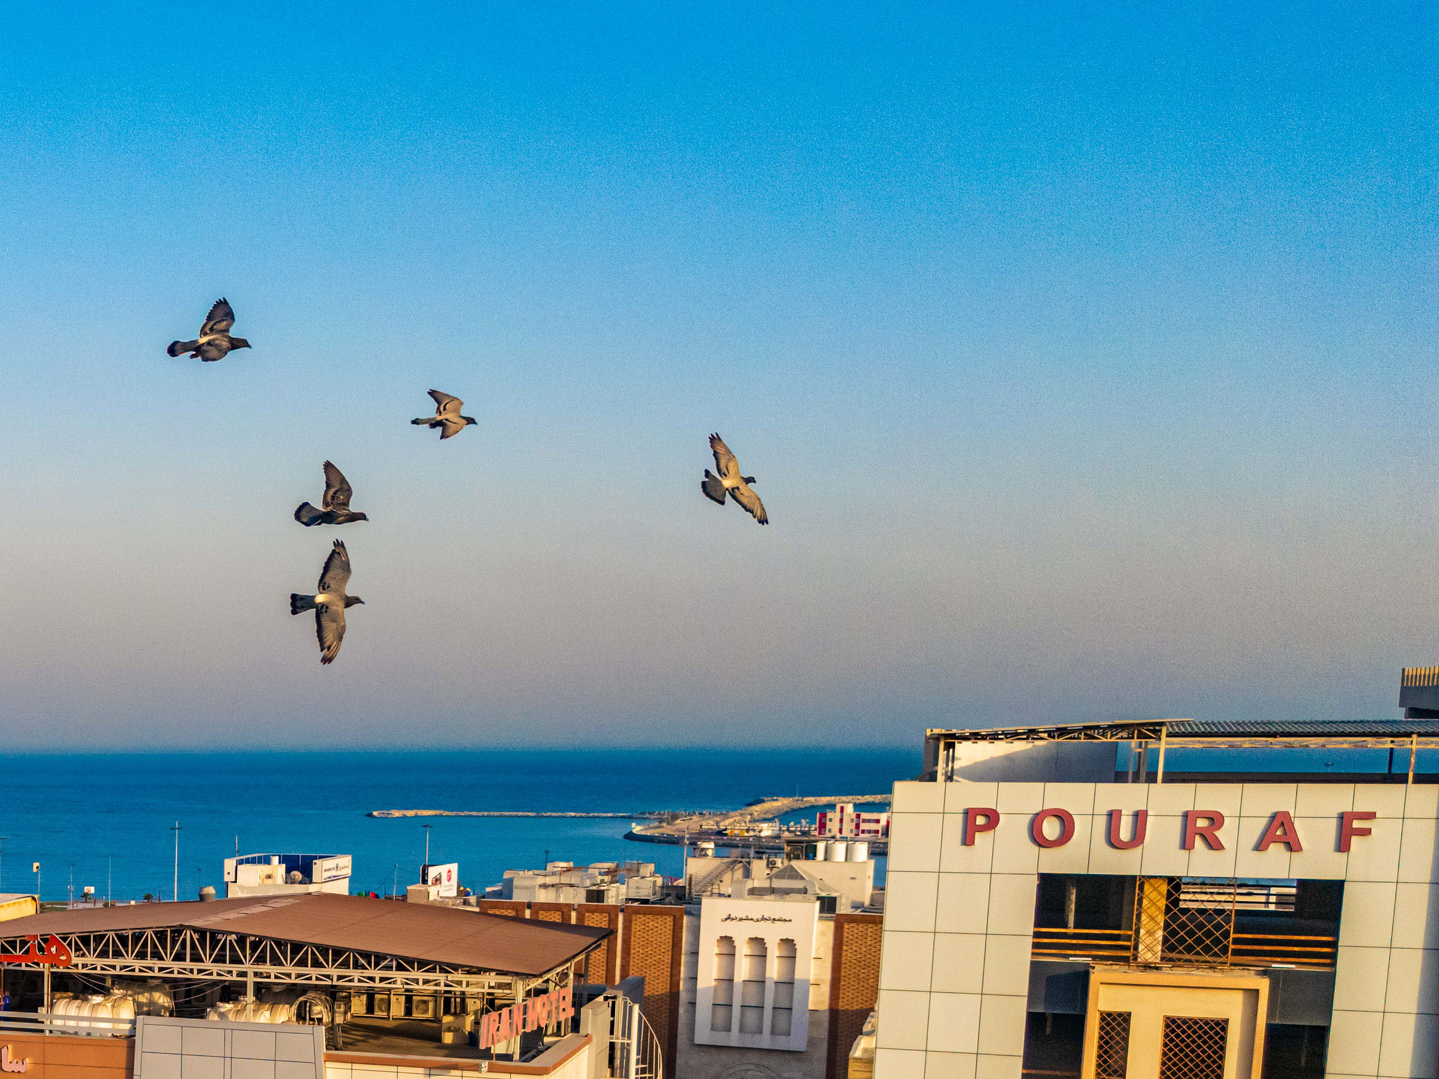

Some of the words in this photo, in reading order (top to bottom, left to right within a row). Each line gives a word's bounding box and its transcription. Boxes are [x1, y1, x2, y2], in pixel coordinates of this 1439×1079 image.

[961, 807, 1378, 853] POURAF
[479, 1002, 523, 1049] IRAN
[524, 987, 575, 1032] HOTEL
